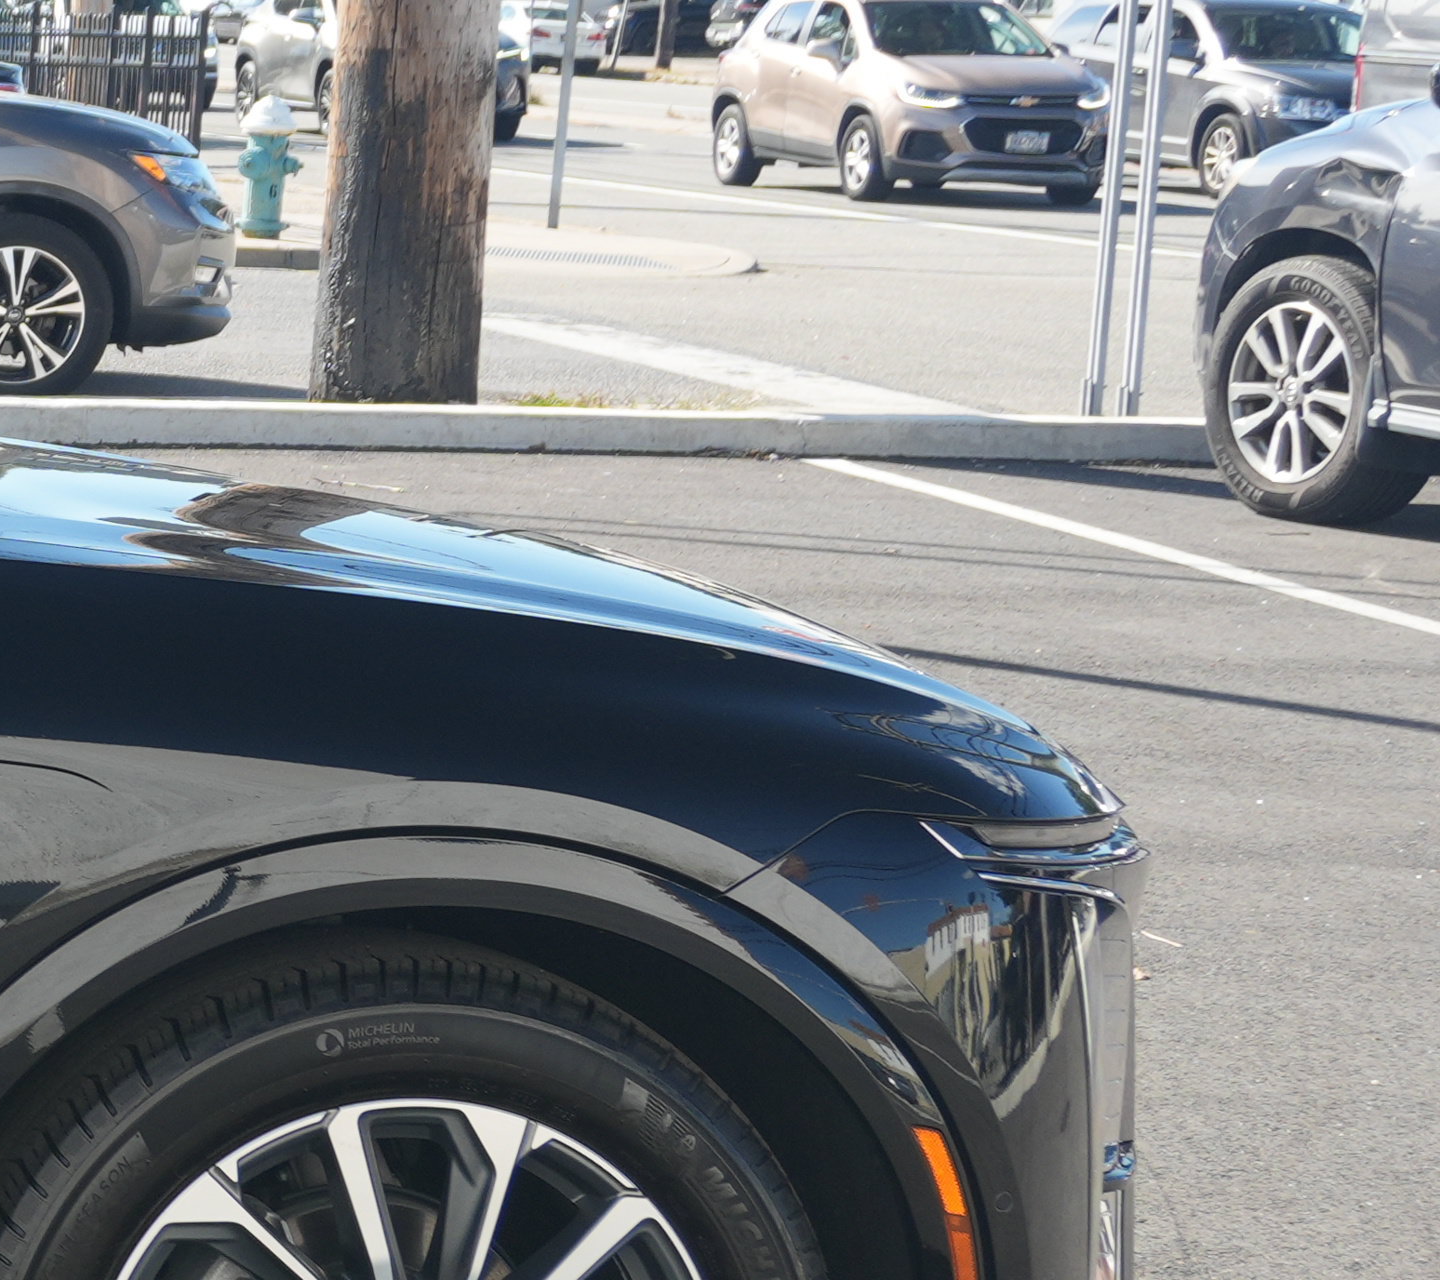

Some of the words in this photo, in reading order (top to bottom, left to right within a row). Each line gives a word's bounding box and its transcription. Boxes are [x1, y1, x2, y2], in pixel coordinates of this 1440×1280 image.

[269, 183, 277, 199] 6
[348, 1022, 415, 1039] MICHELIN
[347, 1039, 371, 1050] Total
[372, 1034, 440, 1046] Performance
